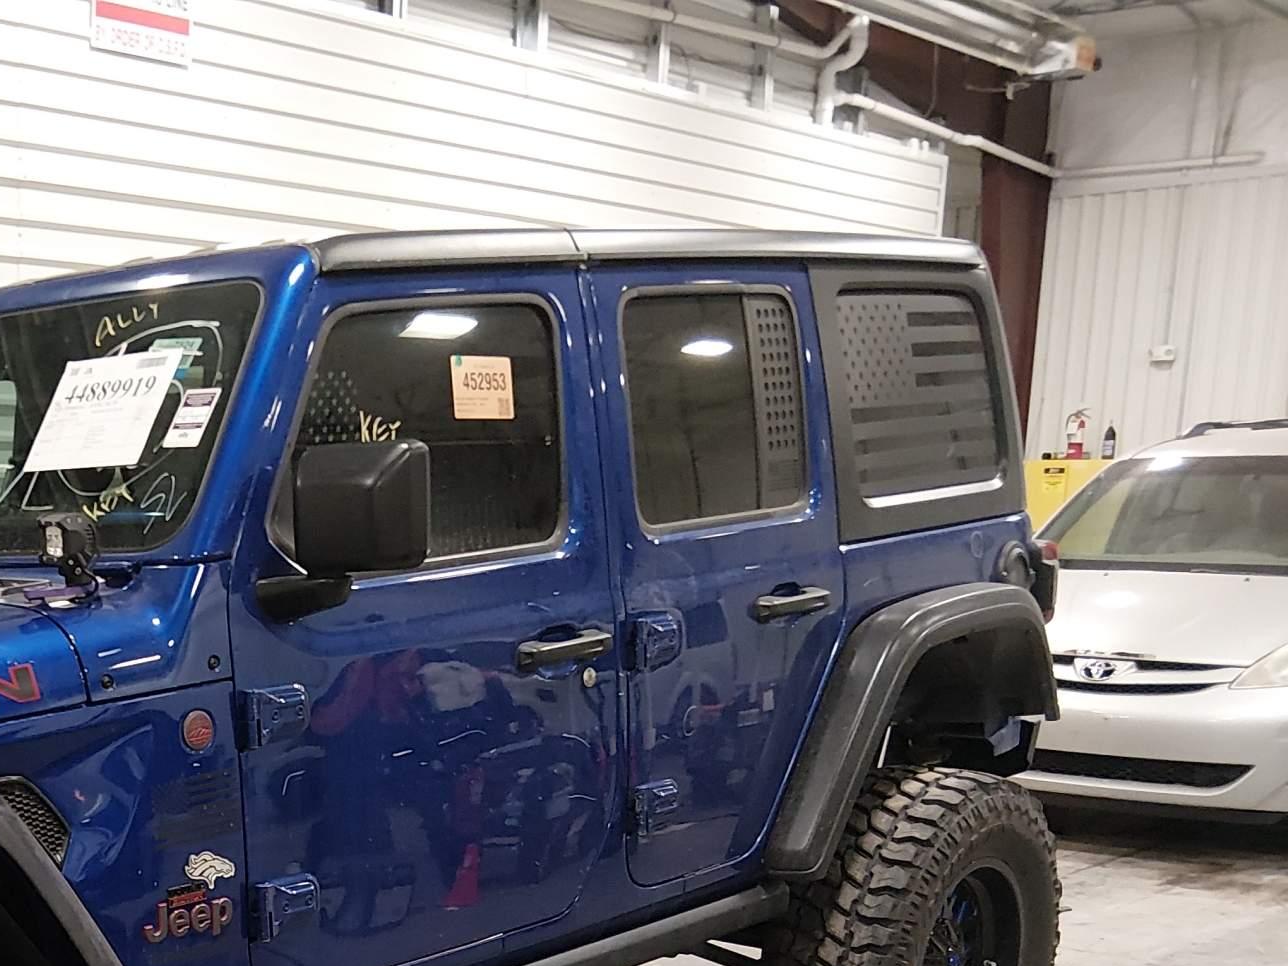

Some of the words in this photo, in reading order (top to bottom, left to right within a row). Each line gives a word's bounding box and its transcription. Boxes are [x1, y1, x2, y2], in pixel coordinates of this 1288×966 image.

[95, 302, 159, 347] ALLY
[64, 375, 157, 405] 44889919
[462, 371, 507, 391] 452953
[358, 410, 402, 443] KEY
[143, 897, 233, 943] Jeep
